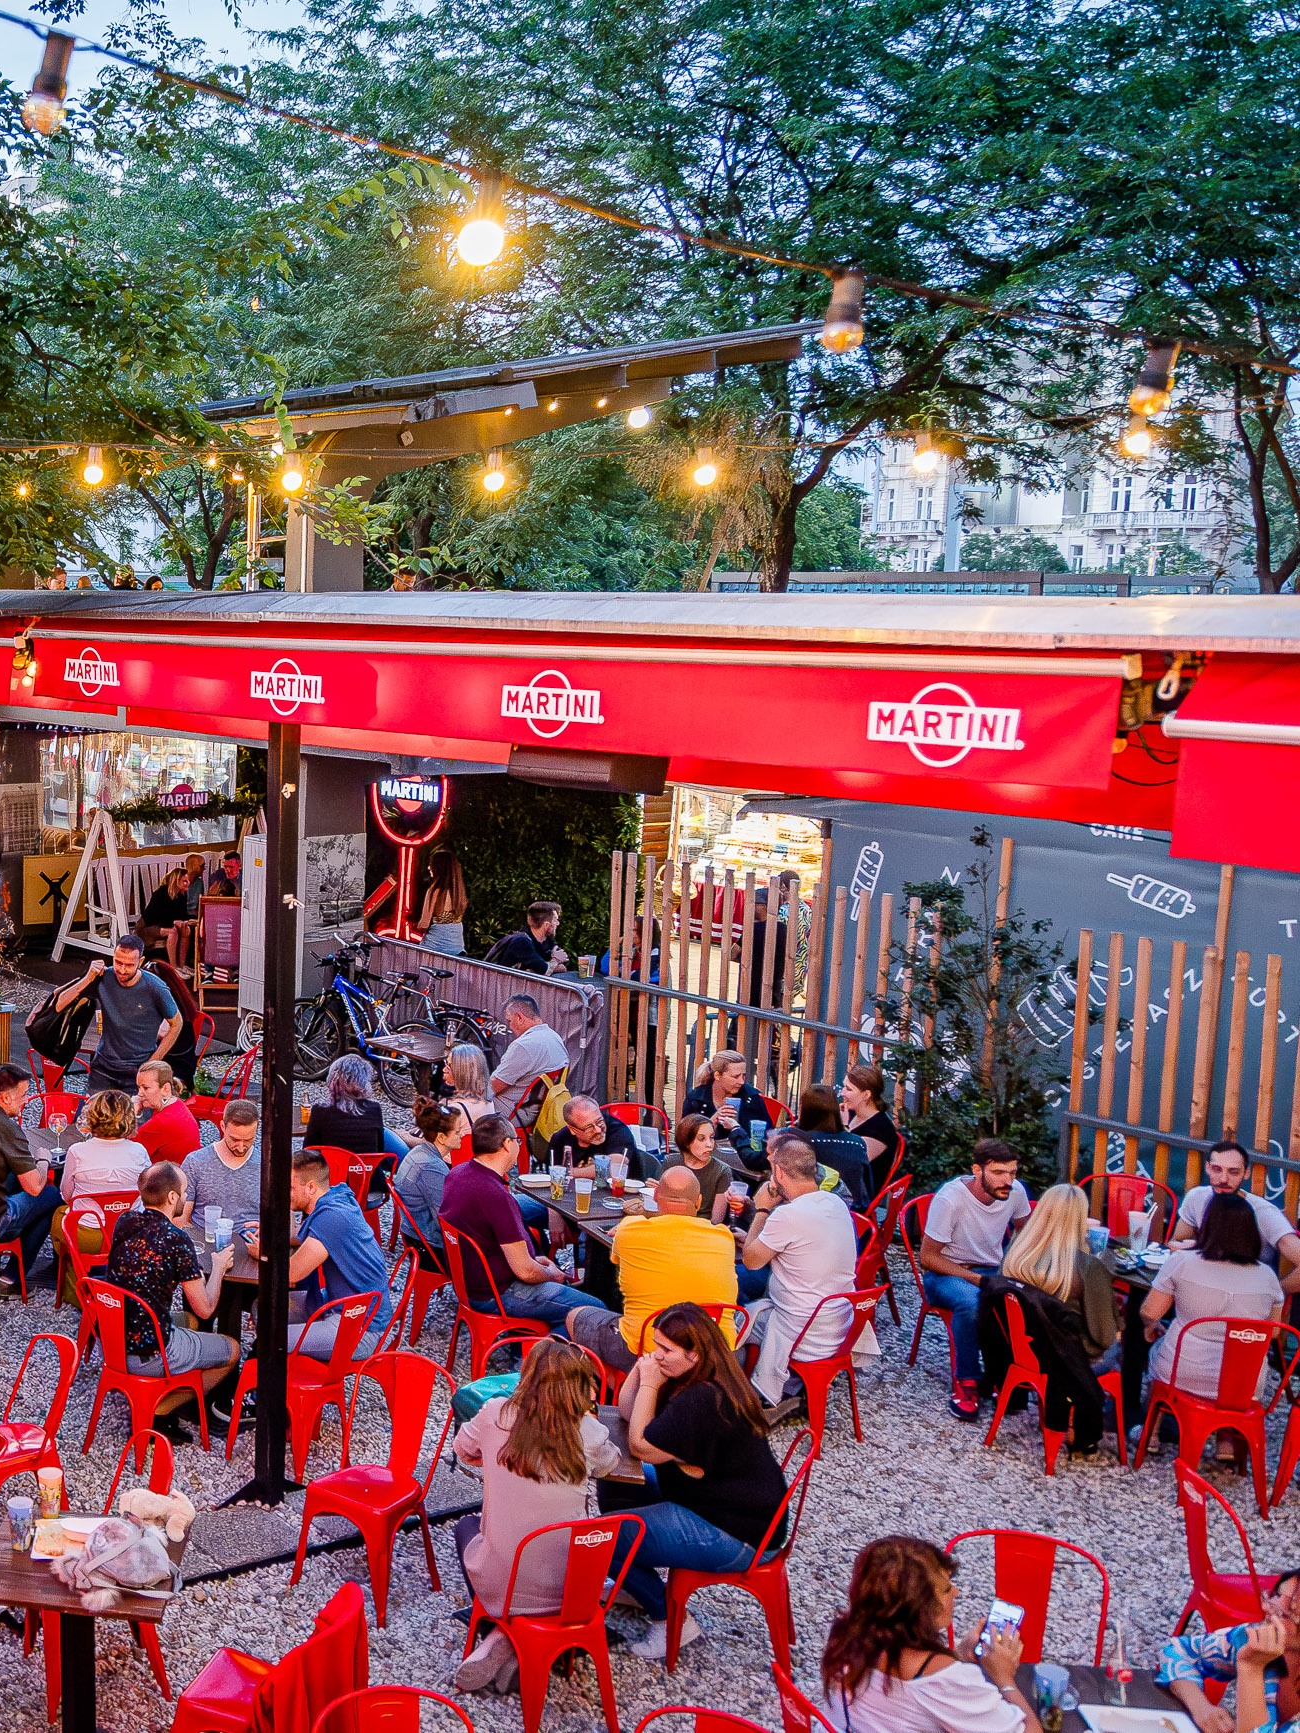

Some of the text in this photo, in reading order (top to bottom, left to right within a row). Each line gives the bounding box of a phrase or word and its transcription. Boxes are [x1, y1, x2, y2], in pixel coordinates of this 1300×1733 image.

[66, 662, 117, 684] MARTINI
[253, 675, 322, 699] MARTINI
[506, 690, 595, 718] MARTINI
[875, 707, 1011, 743] MARTINI
[157, 792, 208, 807] MARTINI
[381, 780, 439, 802] MARTINI
[1090, 823, 1144, 841] CAKE
[575, 1532, 613, 1544] MARTINI
